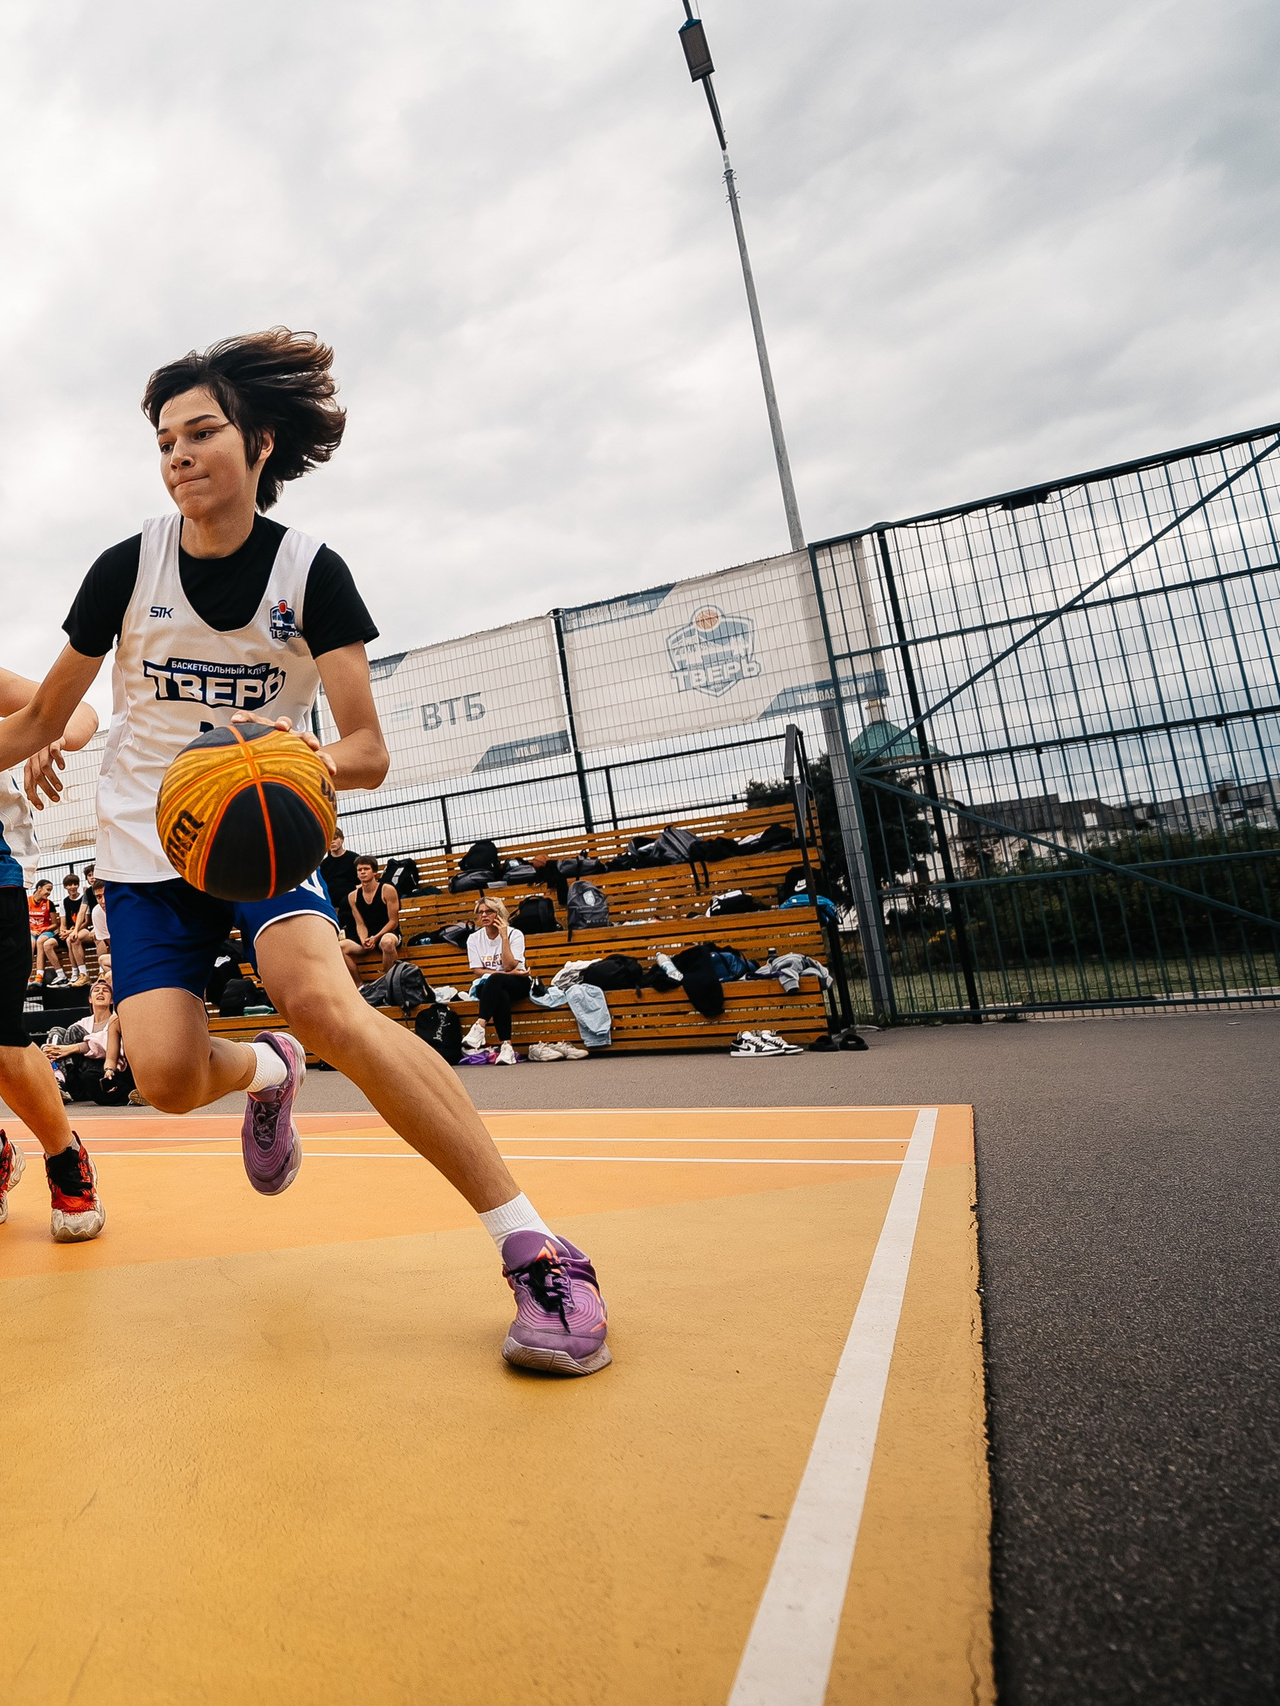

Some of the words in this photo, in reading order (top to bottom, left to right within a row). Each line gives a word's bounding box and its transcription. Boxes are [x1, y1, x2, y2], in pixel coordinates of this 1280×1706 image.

[149, 606, 174, 619] STK
[171, 660, 245, 675] БАСКЕТБОЛЬНЫЙ
[247, 664, 267, 676] КЛУБ
[671, 659, 760, 692] ТВЕРЬ
[146, 665, 285, 707] ТВЕРЬ
[420, 691, 486, 732] ВТБ
